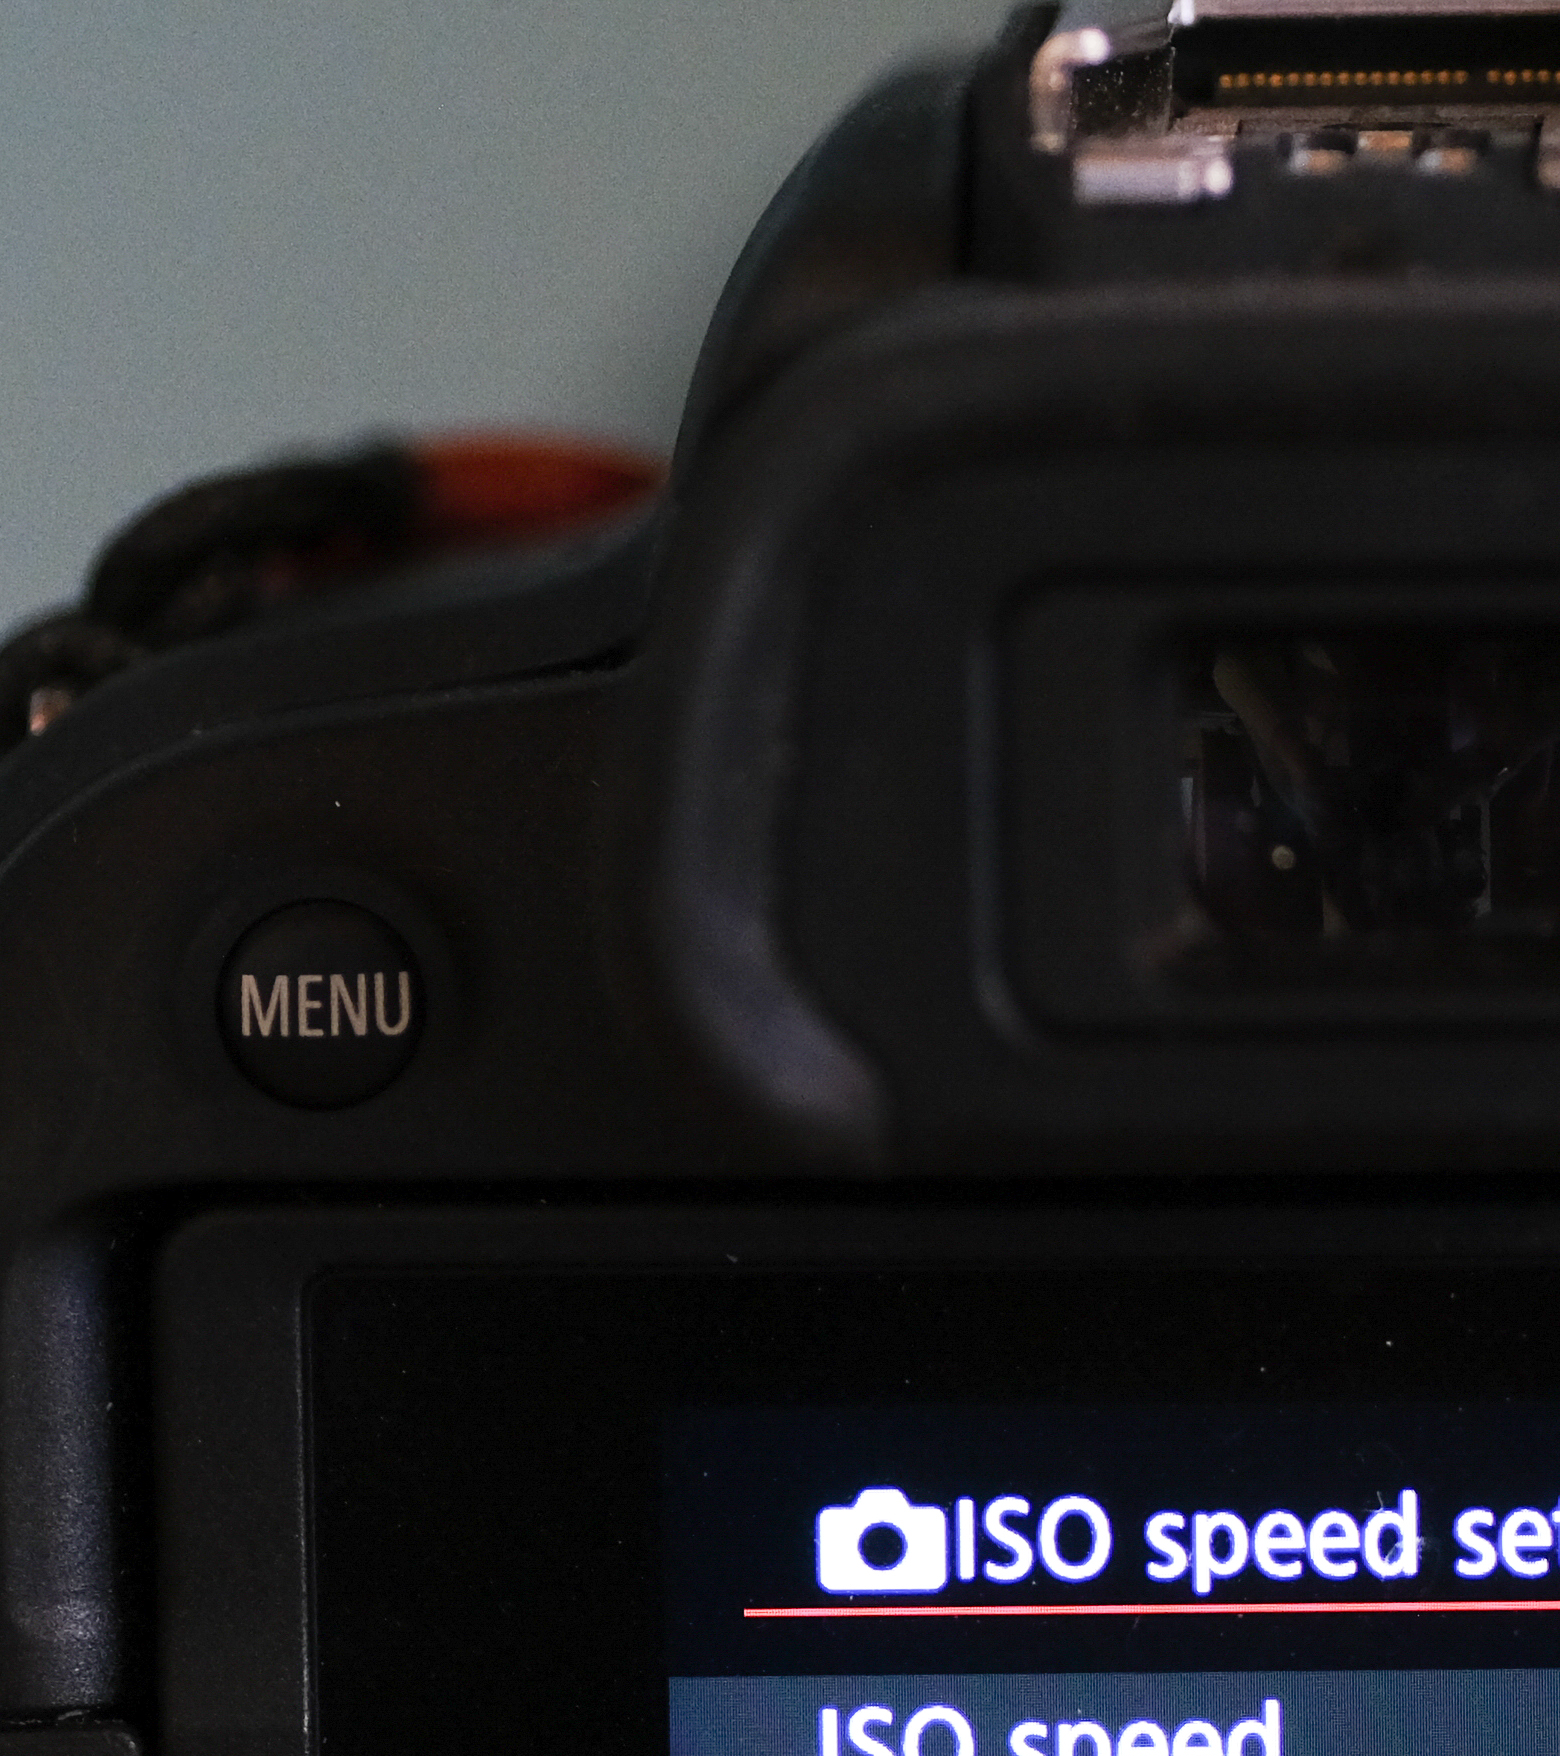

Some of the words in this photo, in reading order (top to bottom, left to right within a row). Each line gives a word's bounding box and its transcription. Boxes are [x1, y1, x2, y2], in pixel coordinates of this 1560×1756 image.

[241, 972, 410, 1037] MENU
[958, 1495, 1112, 1581] ISO
[1146, 1489, 1422, 1594] speed
